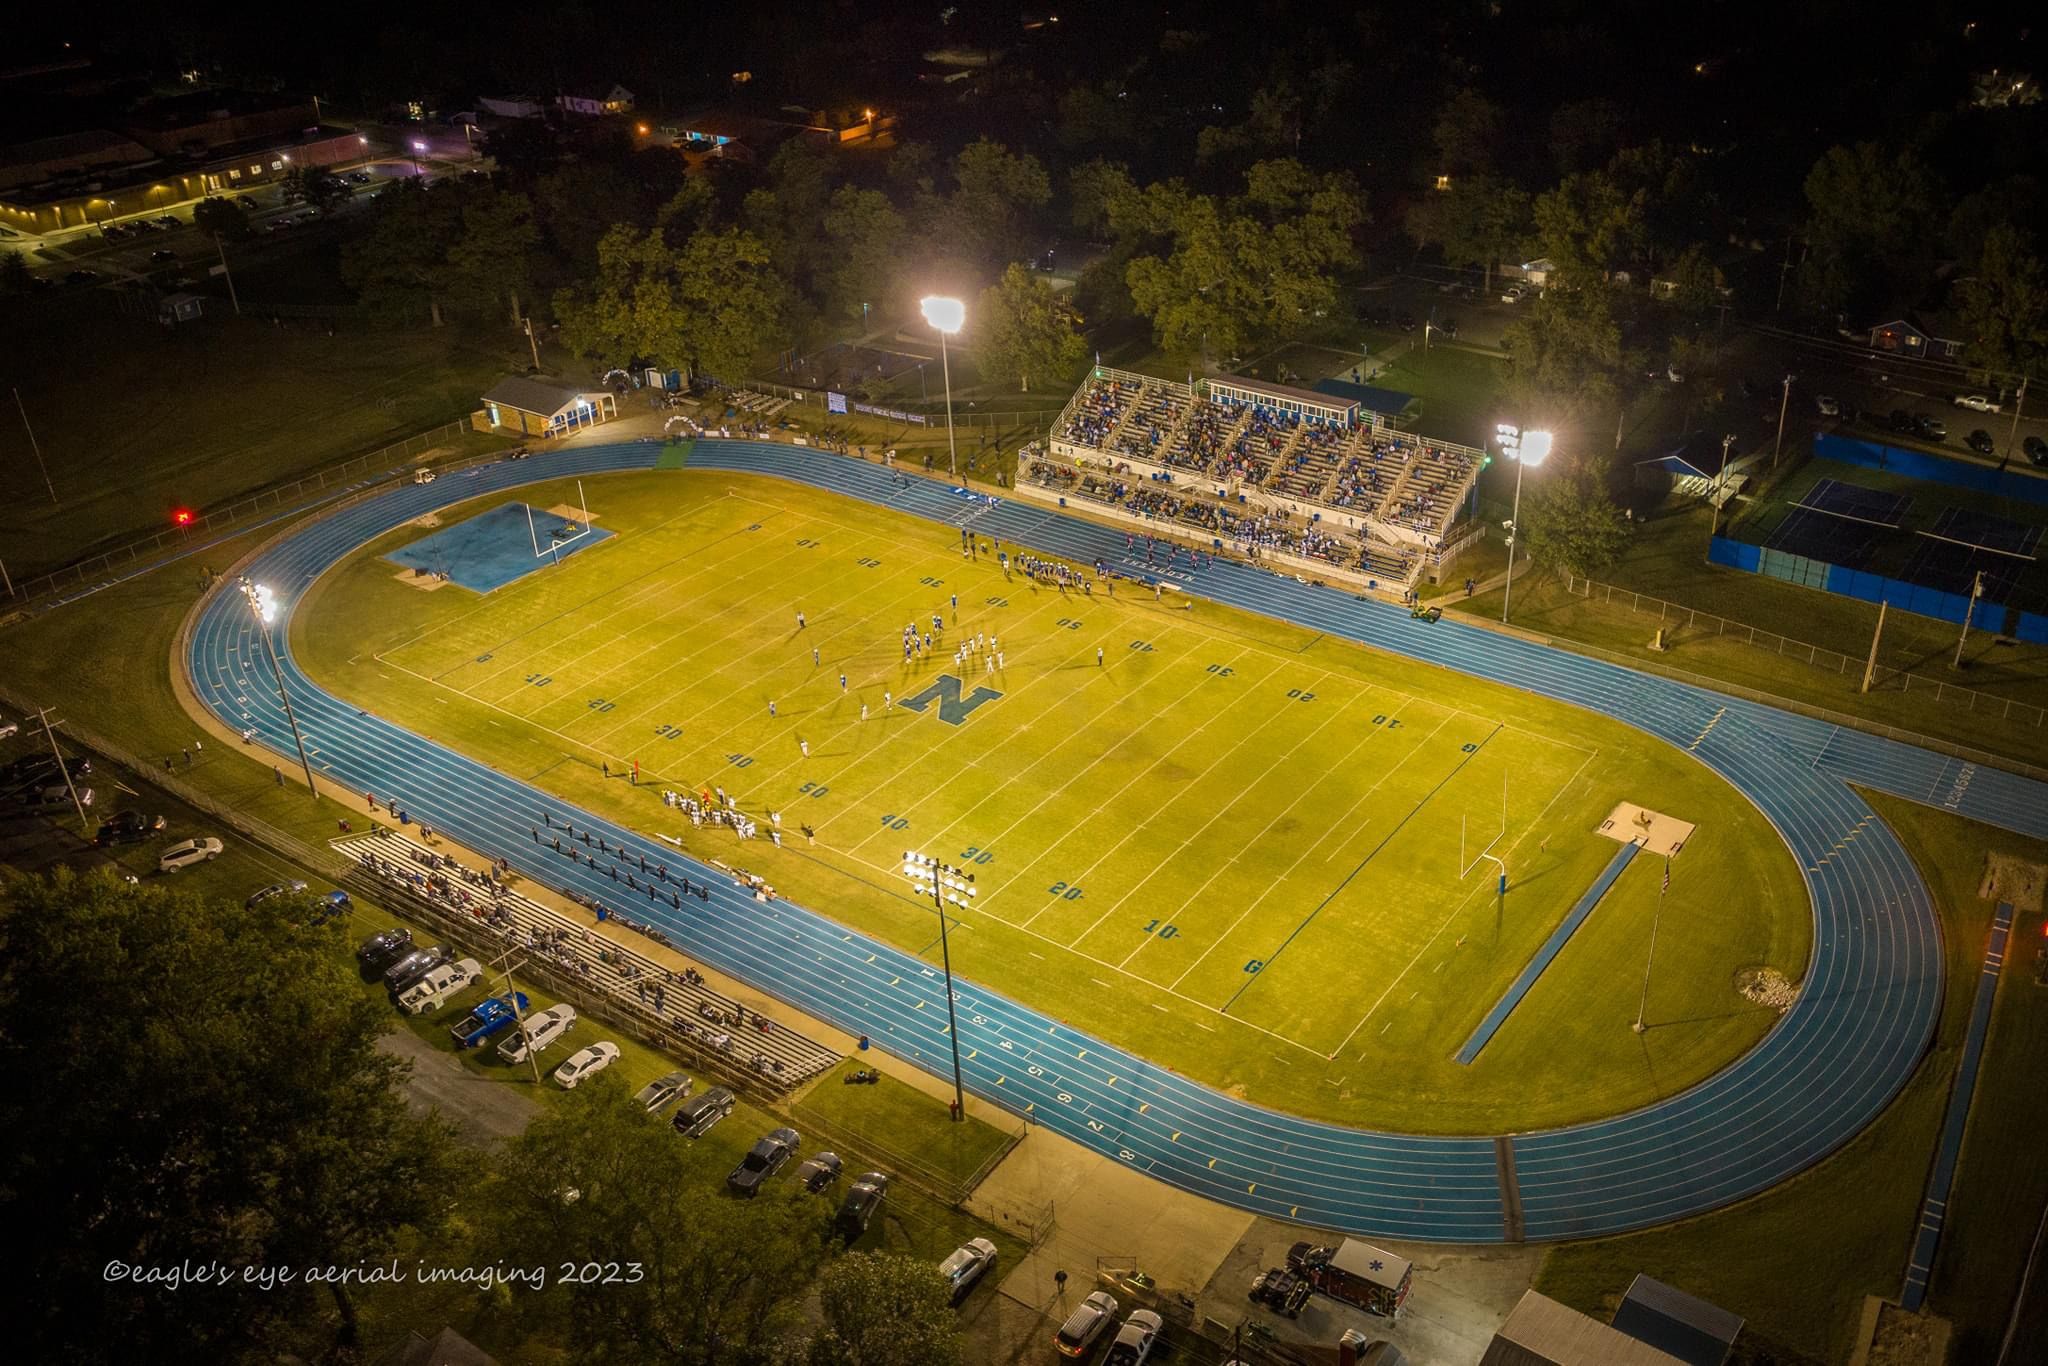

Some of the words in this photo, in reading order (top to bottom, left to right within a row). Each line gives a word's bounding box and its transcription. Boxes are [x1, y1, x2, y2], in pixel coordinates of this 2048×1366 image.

[797, 539, 820, 549] 10
[857, 557, 881, 568] 20
[921, 576, 944, 588] 30
[987, 596, 1008, 608] 40
[1056, 618, 1083, 630] 50
[1129, 640, 1154, 653] 40
[1206, 664, 1234, 677] 30
[526, 673, 552, 687] 10
[895, 673, 1006, 727] N
[1286, 689, 1316, 702] 20
[588, 698, 616, 712] 20
[1371, 715, 1401, 728] 10
[656, 724, 683, 740] 30
[727, 753, 753, 768] 40
[800, 782, 829, 799] 50
[881, 814, 909, 830] 40
[960, 847, 993, 865] 30
[1048, 881, 1083, 900] 20
[1143, 919, 1178, 939] 10
[1243, 959, 1264, 974] G
[920, 968, 935, 977] 1
[972, 1015, 988, 1025] 3
[999, 1040, 1013, 1050] 4
[1028, 1066, 1044, 1077] 5
[1057, 1093, 1073, 1103] 6
[1119, 1150, 1135, 1160] 8
